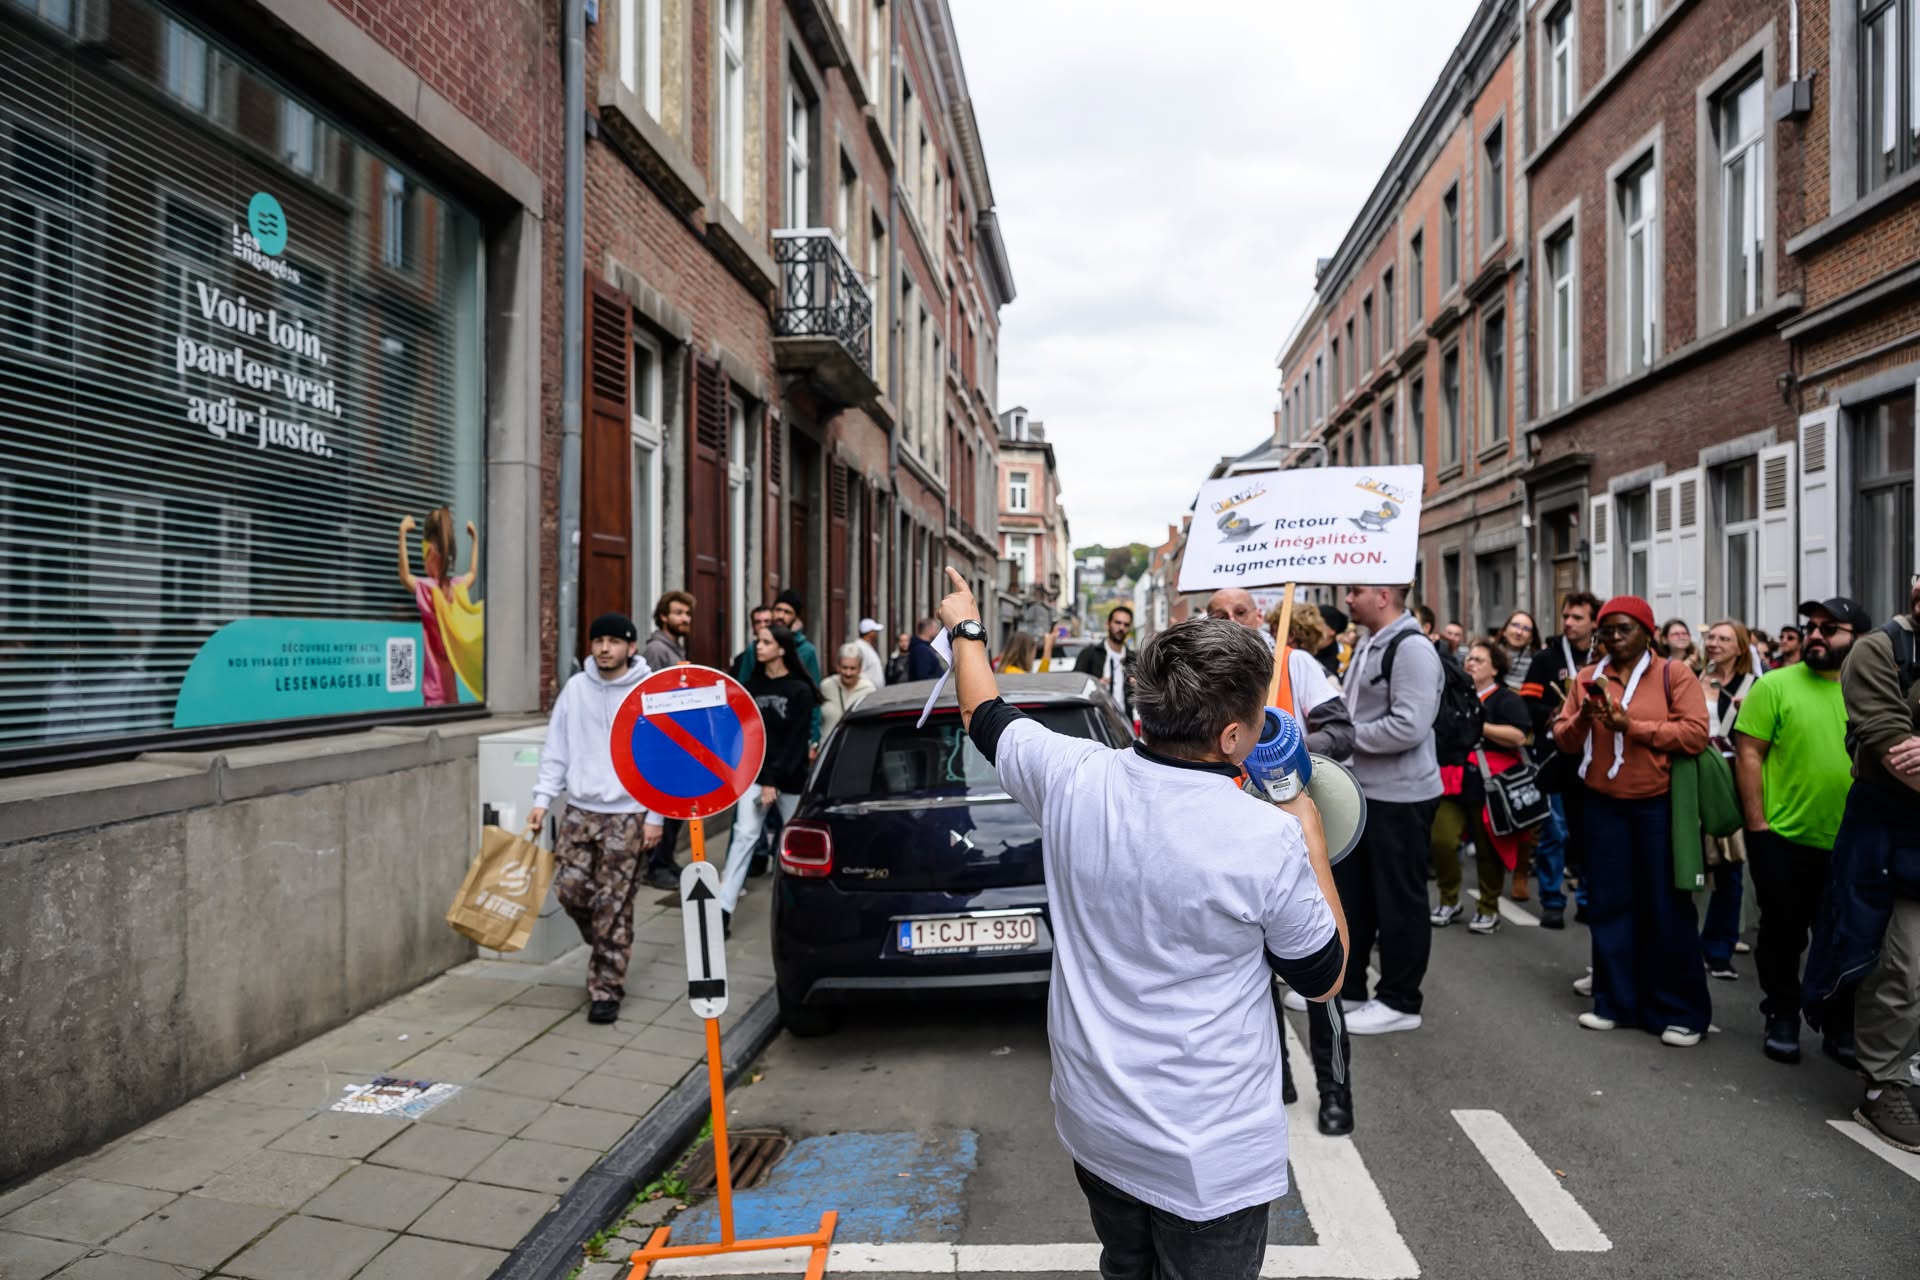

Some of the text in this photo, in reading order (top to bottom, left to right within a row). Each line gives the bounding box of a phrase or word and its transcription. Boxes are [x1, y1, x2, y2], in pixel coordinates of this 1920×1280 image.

[233, 223, 261, 251] Les
[196, 281, 328, 367] Voir loin,
[176, 335, 342, 419] parler vrai,
[187, 397, 333, 458] agir juste.
[1274, 516, 1339, 530] Retour
[1235, 533, 1368, 553] aux inégalités
[1213, 551, 1388, 576] augmentées NON.
[228, 657, 248, 669] NOS
[251, 656, 290, 668] VISAGES
[292, 657, 303, 667] ET
[275, 673, 381, 692] LESENGAGES.BE
[915, 919, 1032, 944] 1-CJT-930
